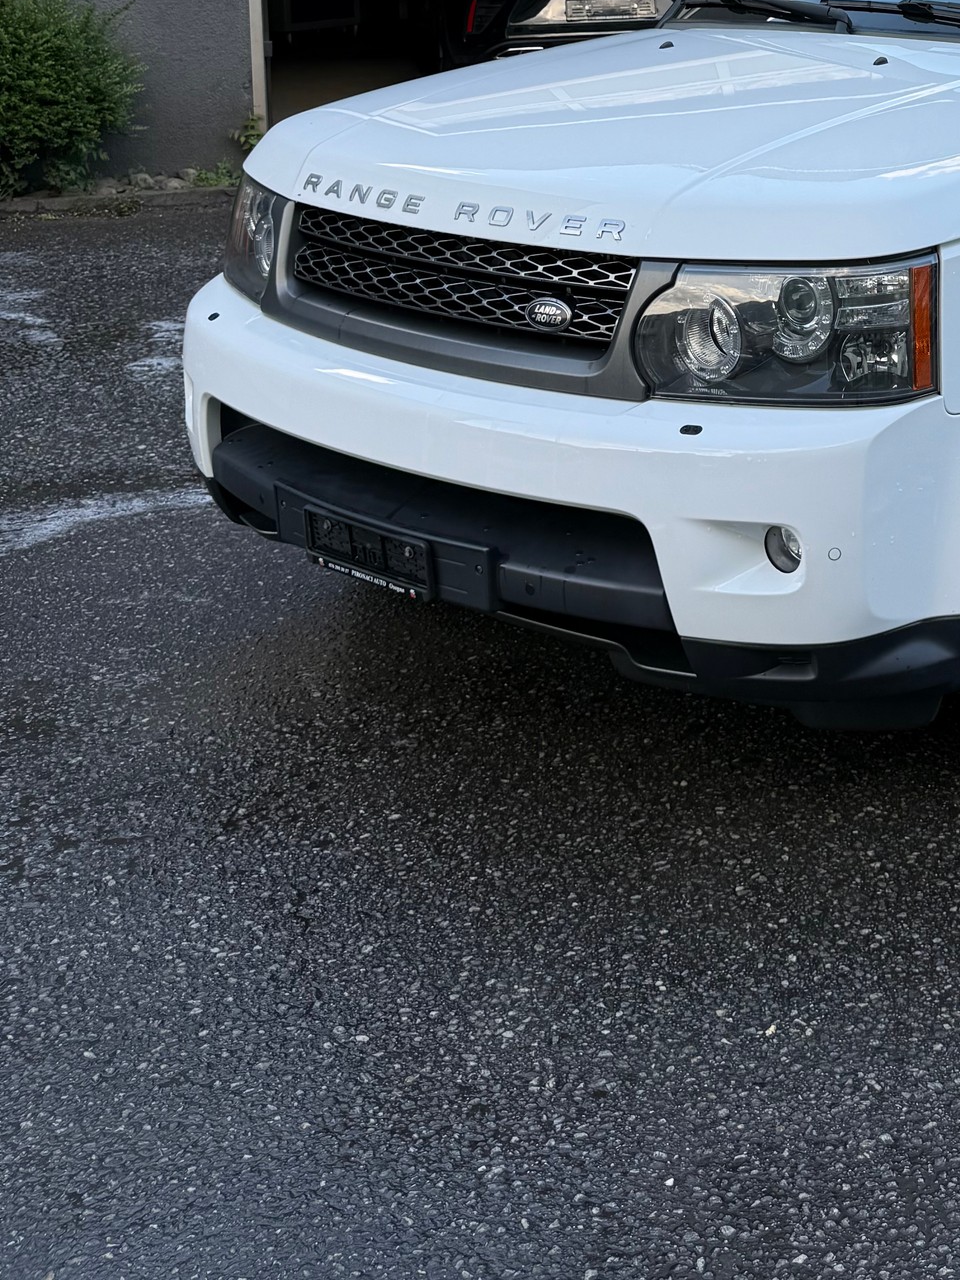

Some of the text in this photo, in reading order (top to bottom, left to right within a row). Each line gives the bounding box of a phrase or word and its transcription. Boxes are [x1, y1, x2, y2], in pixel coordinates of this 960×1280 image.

[303, 173, 627, 241] RANGE ROVER
[534, 305, 556, 315] LAND
[535, 313, 562, 324] ROVER
